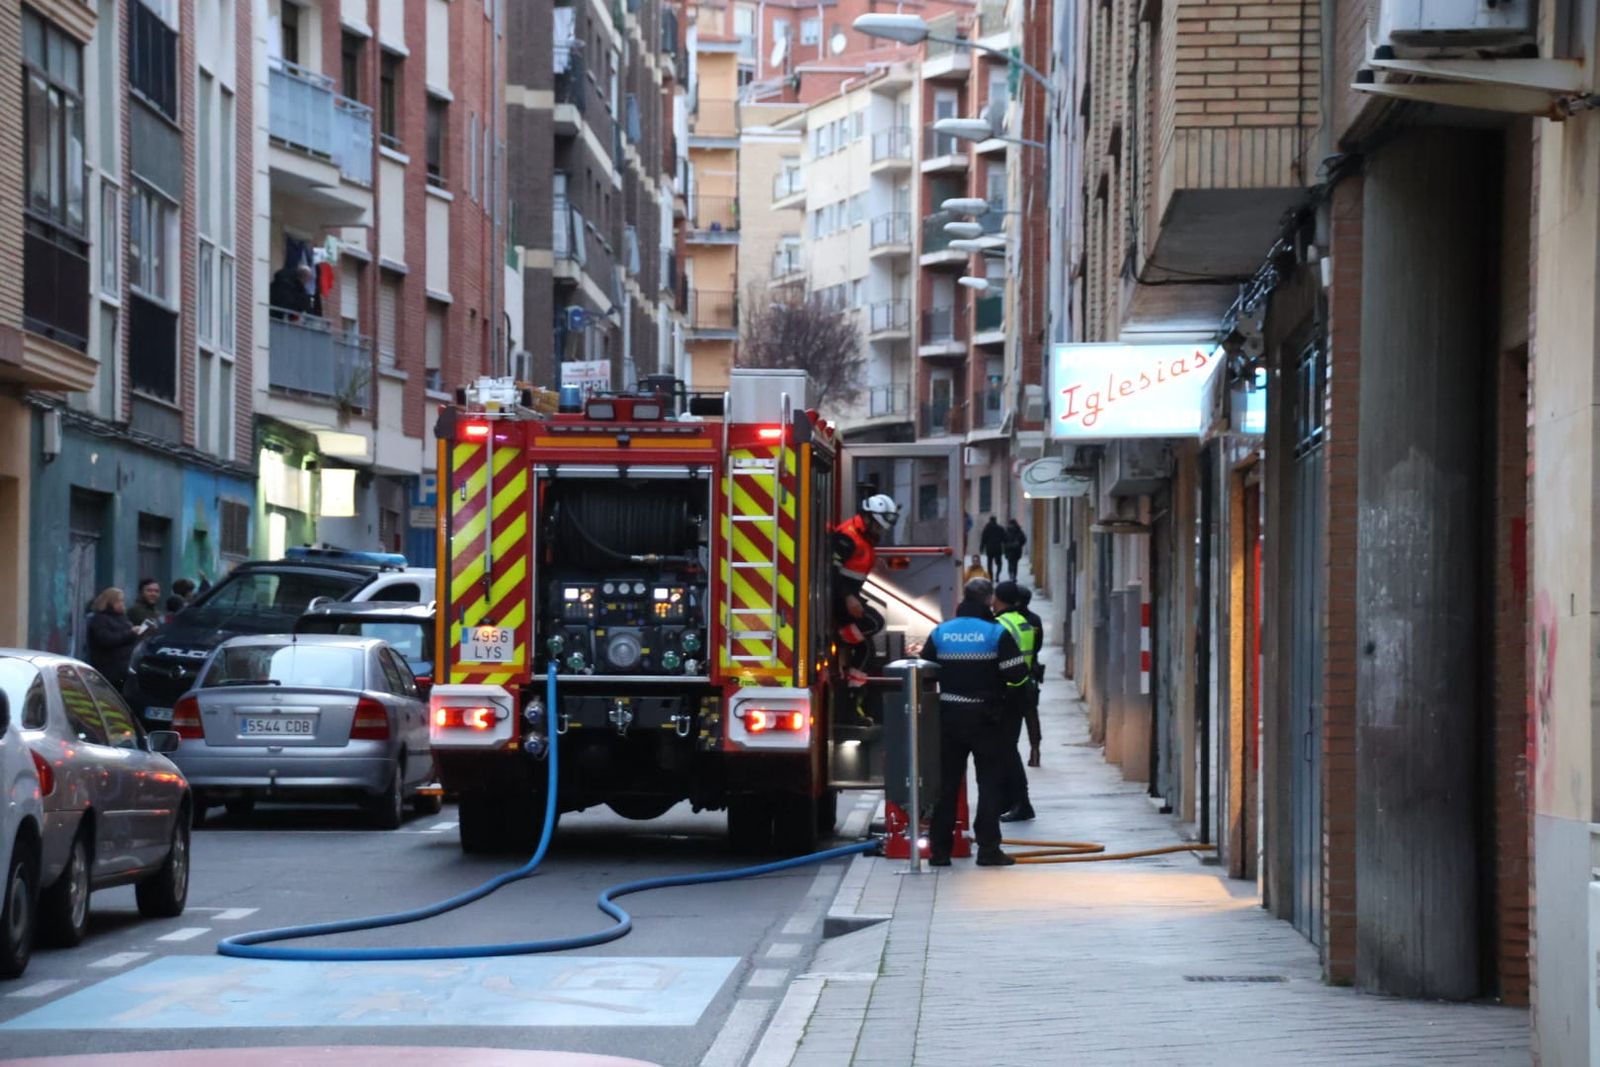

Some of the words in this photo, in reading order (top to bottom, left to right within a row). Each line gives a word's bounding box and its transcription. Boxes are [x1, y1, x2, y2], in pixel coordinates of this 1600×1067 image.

[1061, 350, 1207, 427] Iglesias
[472, 629, 509, 644] 4956
[942, 631, 985, 642] POLICÍA
[474, 645, 502, 659] LYS
[248, 720, 280, 732] 5544
[286, 721, 310, 733] CDB
